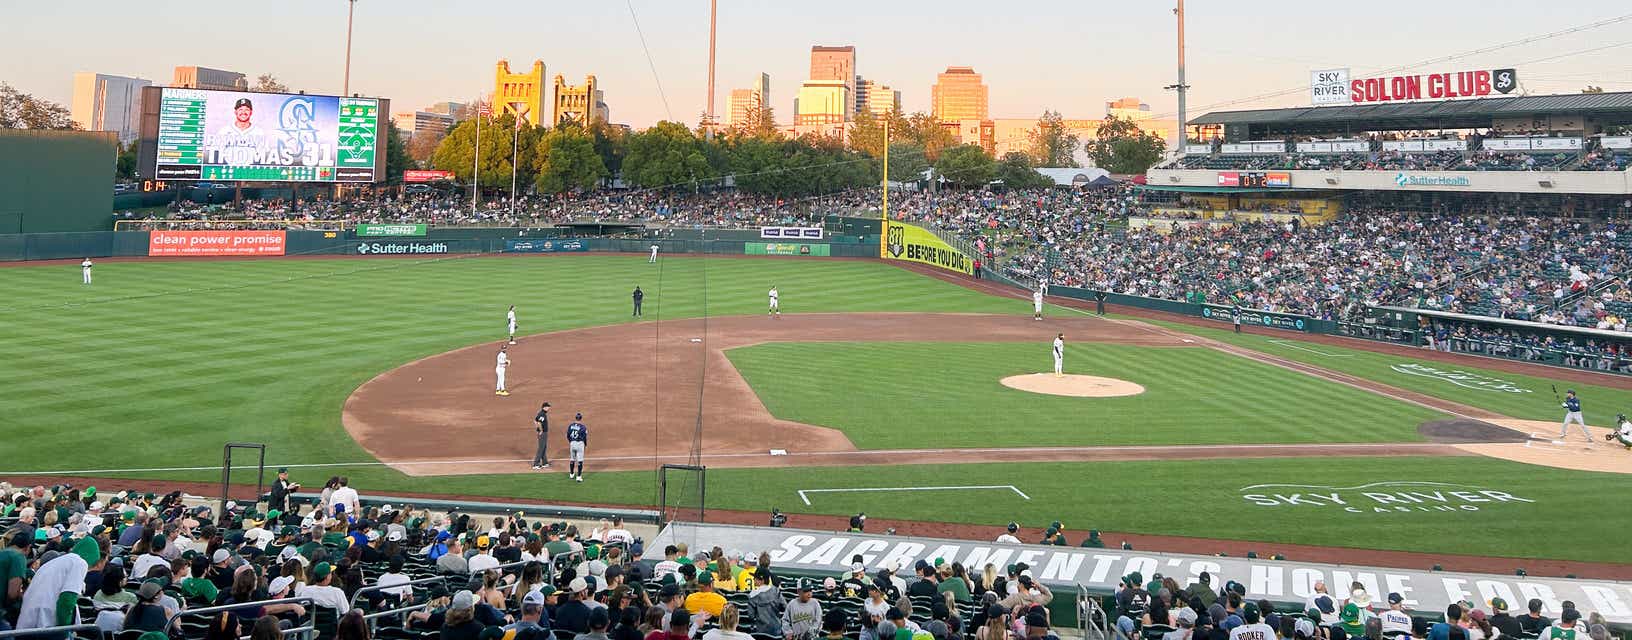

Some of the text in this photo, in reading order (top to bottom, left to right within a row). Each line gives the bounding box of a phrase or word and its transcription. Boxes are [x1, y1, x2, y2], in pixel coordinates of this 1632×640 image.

[1319, 72, 1339, 82] SKY
[1314, 85, 1346, 96] RIVER
[1351, 70, 1491, 103] SOLON CLUB
[206, 142, 334, 167] THOMAS 31
[1409, 175, 1469, 185] Sutter Health
[153, 234, 282, 247] clean power promise
[888, 226, 904, 246] 811
[371, 242, 448, 254] Sutter Health
[907, 244, 964, 270] BEFORE YOU DIG
[1243, 490, 1536, 505] SKY RIVER
[1344, 504, 1480, 512] CASINO
[771, 535, 1221, 596] SACRAMENTO'S
[1250, 565, 1418, 606] HOME
[1441, 577, 1561, 616] FOR
